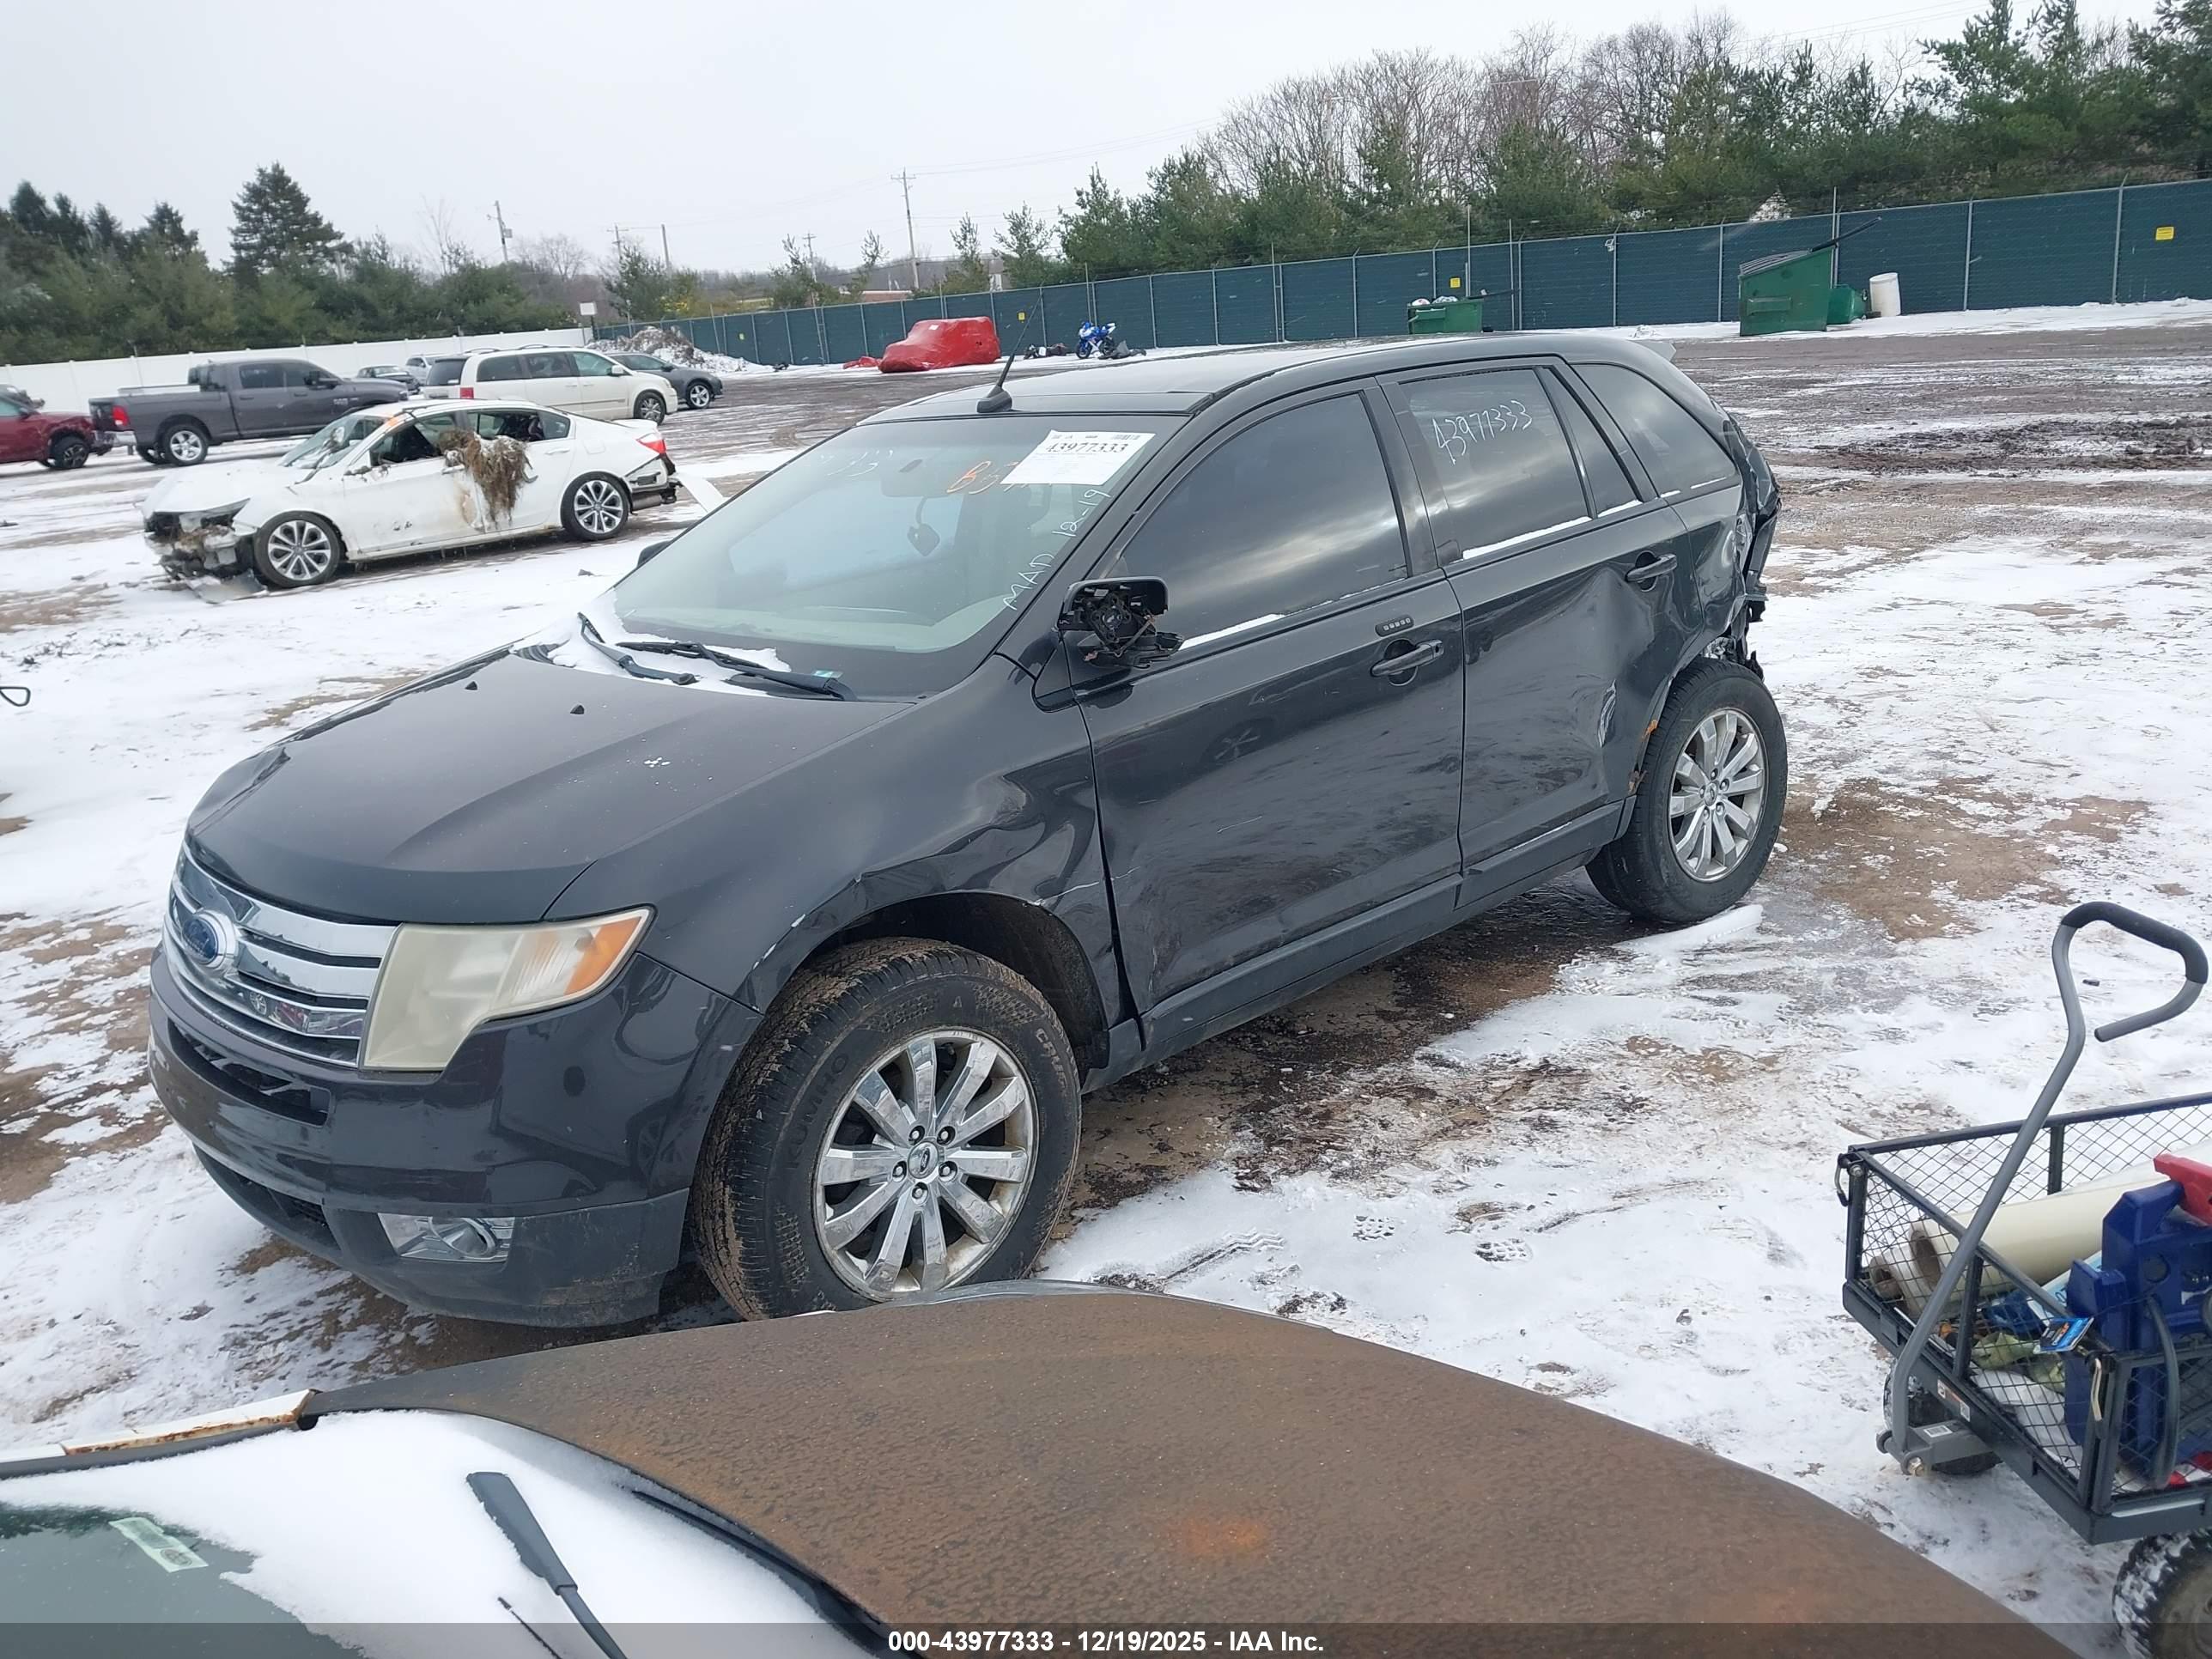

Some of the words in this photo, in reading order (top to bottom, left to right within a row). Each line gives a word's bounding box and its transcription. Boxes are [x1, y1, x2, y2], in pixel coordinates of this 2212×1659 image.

[1045, 441, 1129, 453] 43977333
[1002, 552, 1055, 611] MAD
[1050, 489, 1112, 537] 12-19
